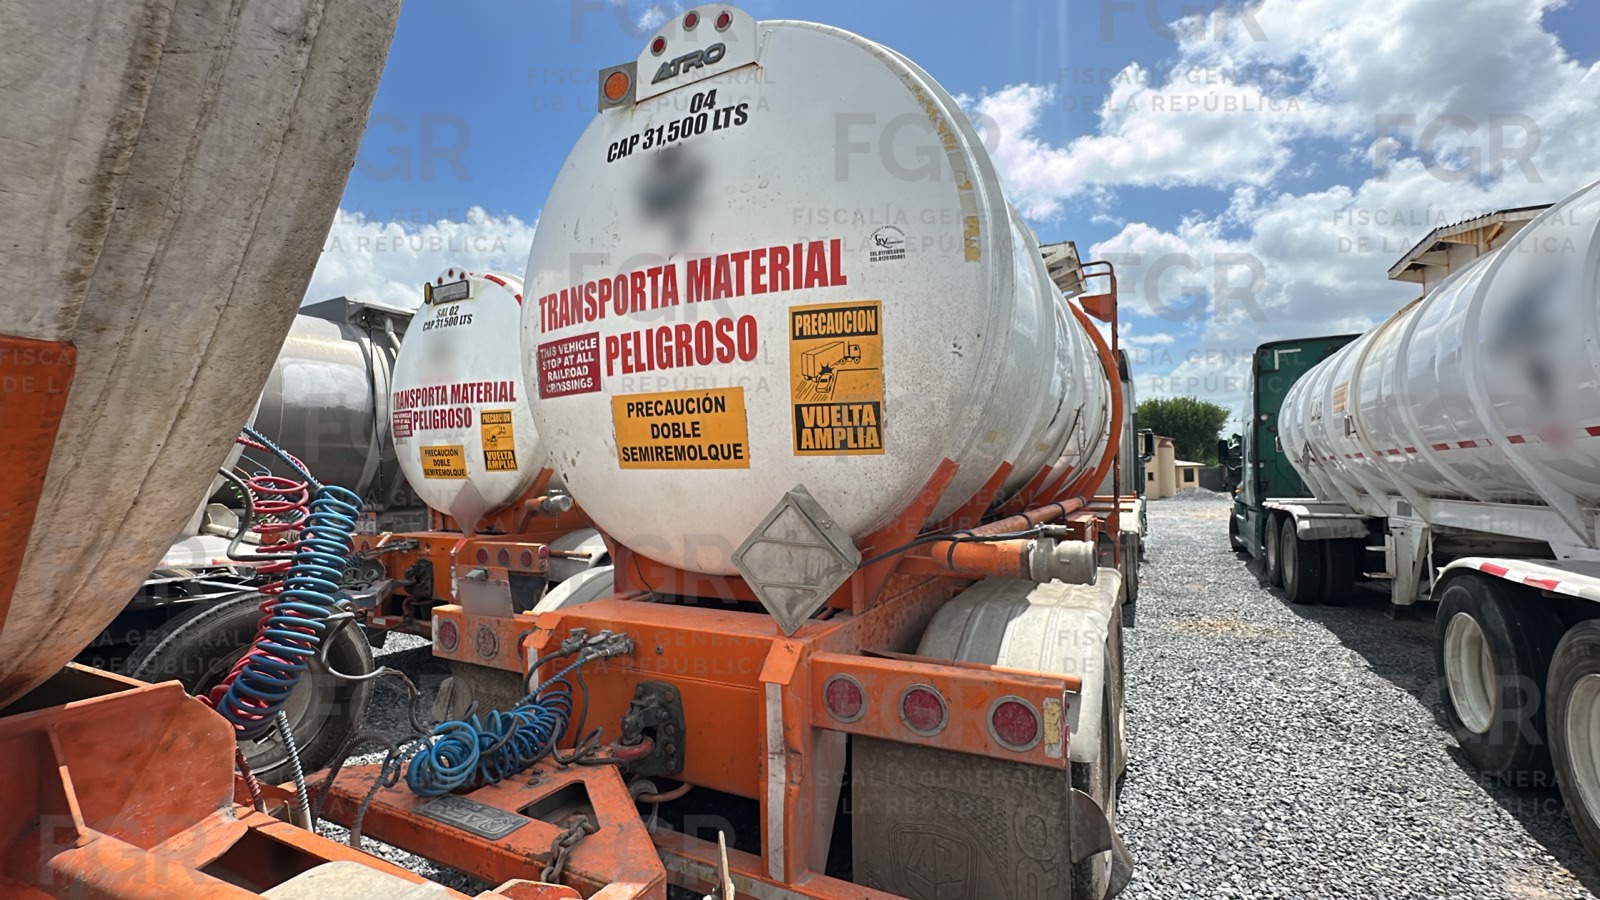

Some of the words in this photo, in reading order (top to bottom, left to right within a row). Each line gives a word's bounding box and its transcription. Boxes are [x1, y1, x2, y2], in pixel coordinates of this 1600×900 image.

[651, 42, 727, 85] ATRO
[690, 89, 718, 115] 04
[607, 133, 640, 164] CAP
[642, 112, 709, 150] 31,500
[712, 103, 749, 131] LTS
[539, 263, 680, 334] TRANSPORTA
[686, 238, 847, 304] MATERIAL
[422, 320, 435, 332] CAP
[459, 313, 473, 326] LTS
[449, 305, 460, 317] 02
[794, 308, 876, 338] PRECAUCION
[540, 346, 557, 359] THIS
[558, 337, 597, 355] VEHICLE
[605, 314, 758, 377] PELIGROSO
[542, 357, 562, 370] STOP
[563, 354, 574, 367] AT
[576, 351, 595, 364] ALL
[547, 365, 589, 381] RAILROAD
[393, 385, 448, 411] TRANSPORTA
[450, 381, 517, 405] MATERIAL
[546, 377, 593, 394] CROSSINGS
[627, 392, 726, 418] PRECAUCIÓN
[800, 404, 877, 429] VUELTA
[413, 407, 473, 431] PELIGROSO
[650, 421, 701, 440] DOBLE
[800, 426, 881, 450] AMPLIA
[433, 459, 451, 467] DOBLE
[486, 451, 514, 461] VUELTA
[487, 459, 517, 470] AMPLIA
[622, 443, 744, 463] SEMIREMOLQUE
